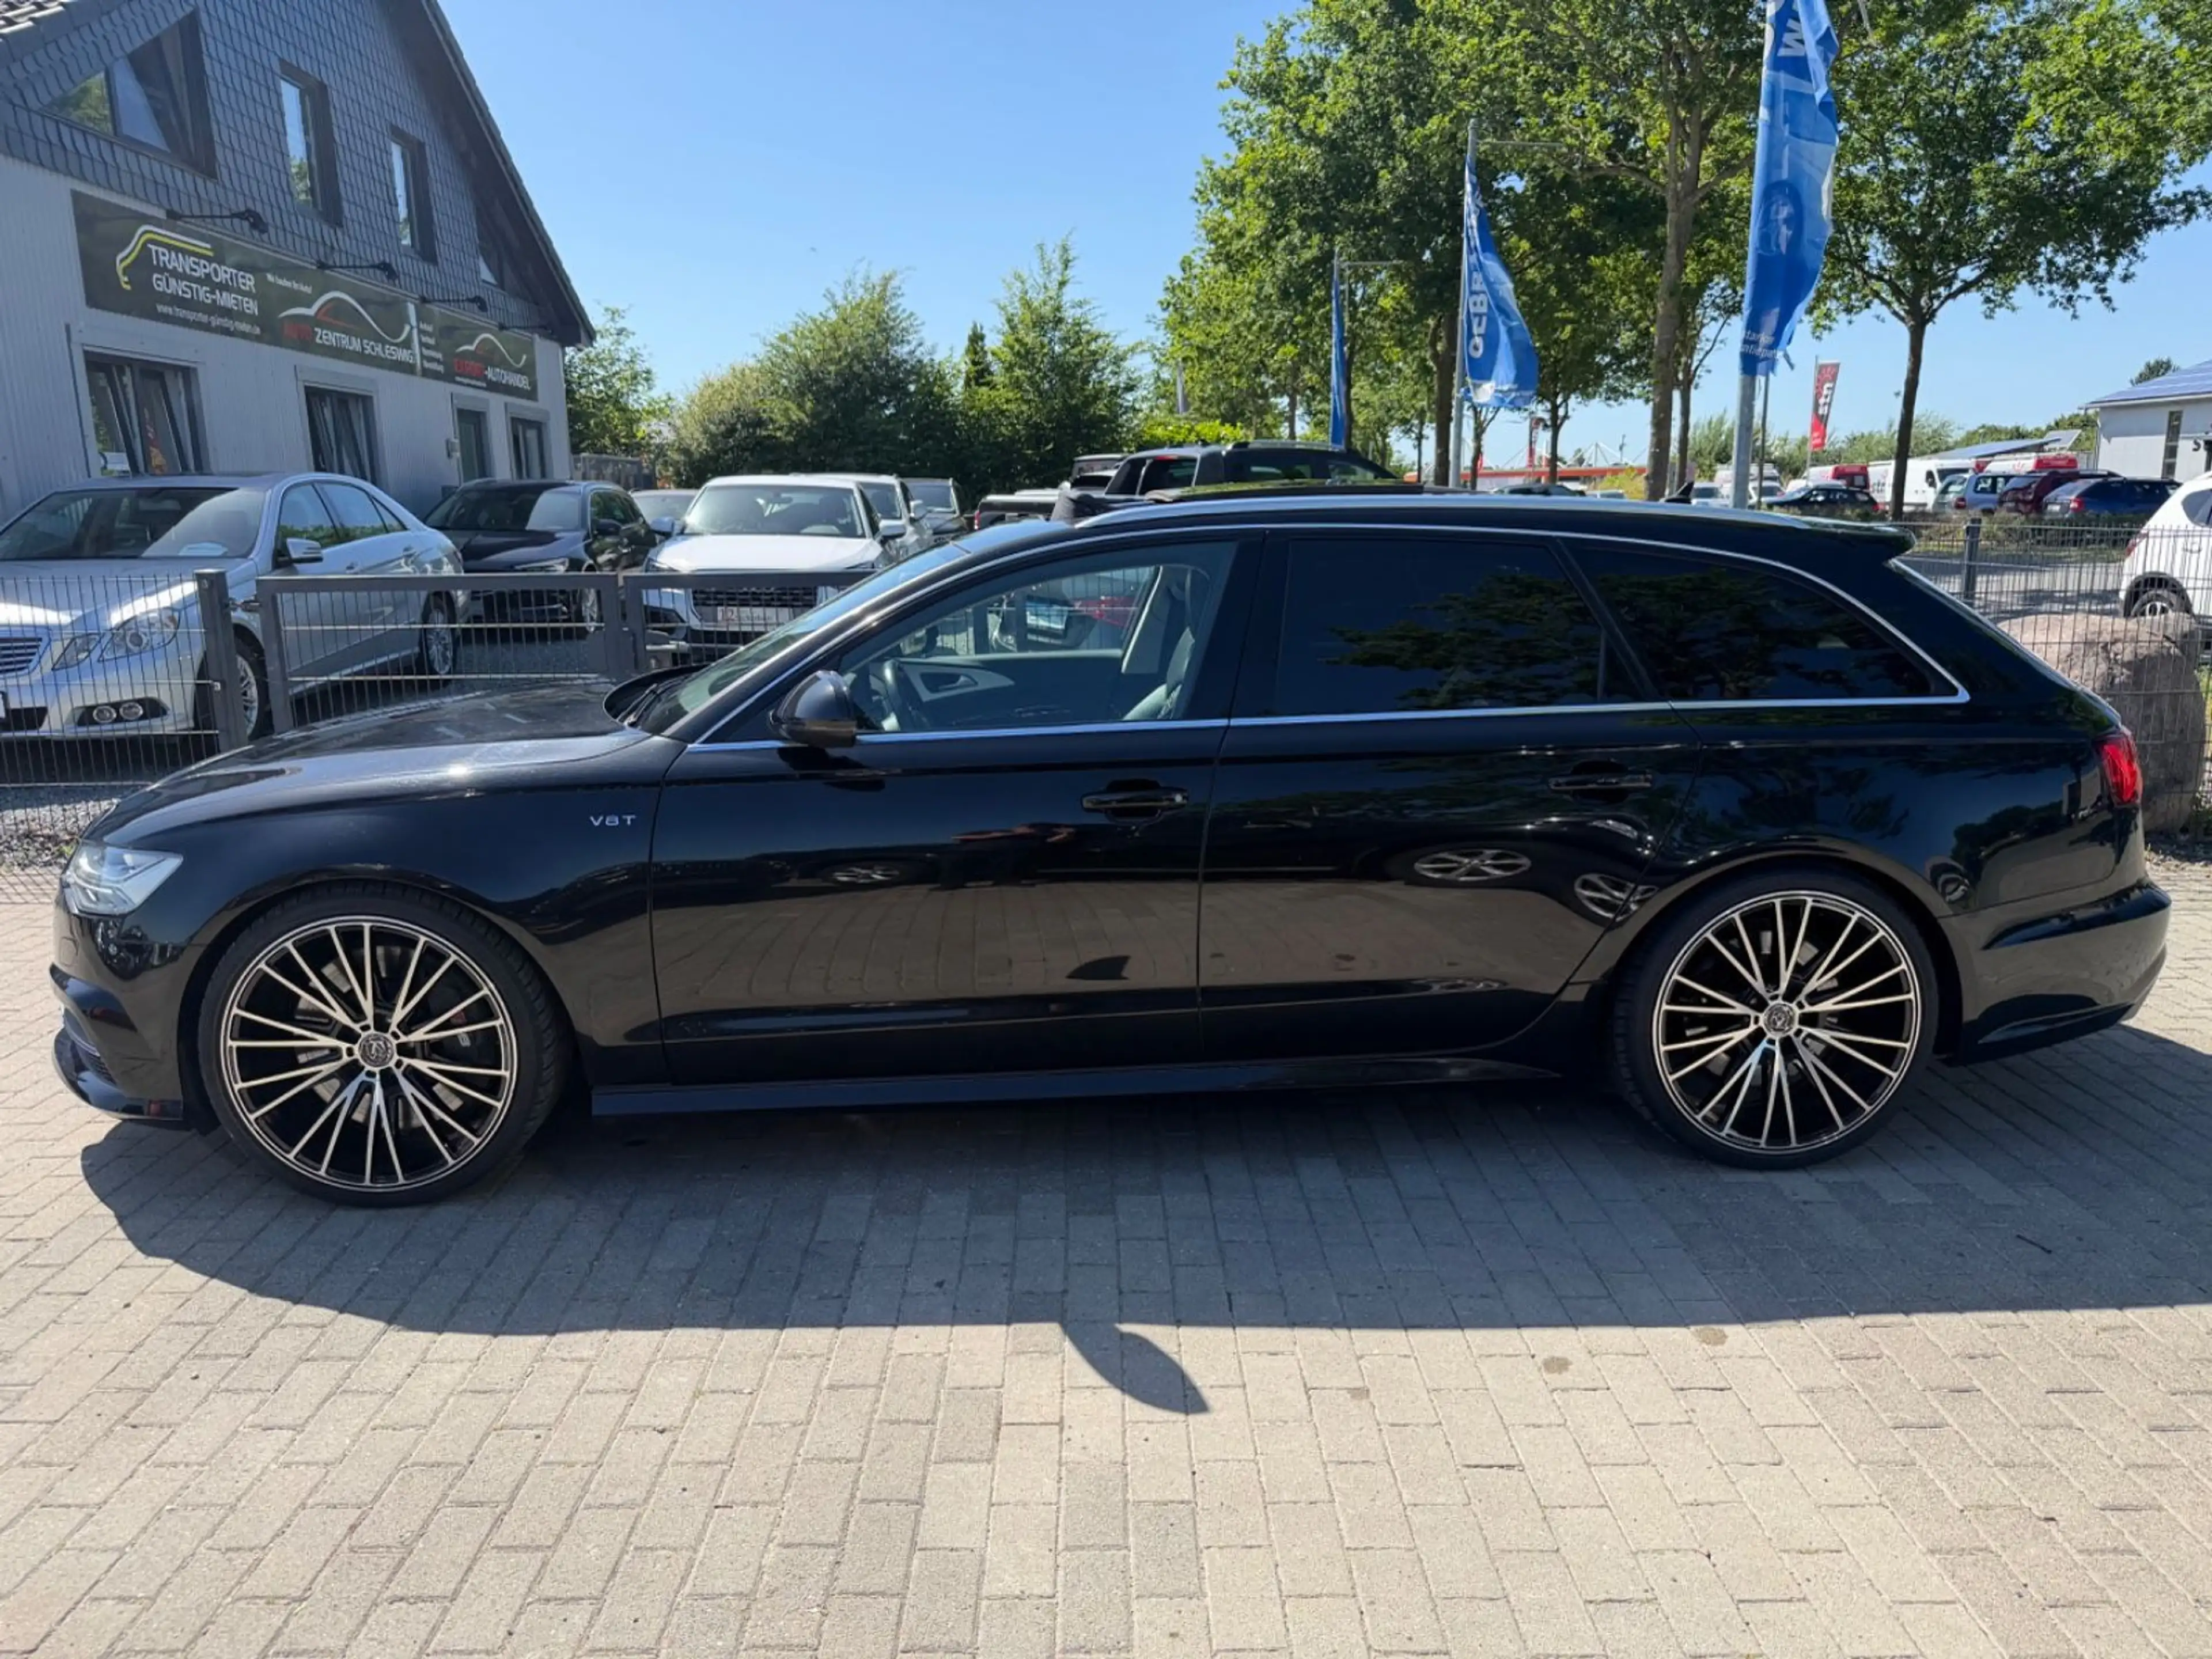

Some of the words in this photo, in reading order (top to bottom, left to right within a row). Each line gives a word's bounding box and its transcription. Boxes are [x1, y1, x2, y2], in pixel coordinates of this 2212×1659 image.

[147, 243, 256, 293] TRANSPORTER
[153, 272, 259, 316] GÜNSTIG-MIETEN
[314, 327, 362, 354] ZENTRUM
